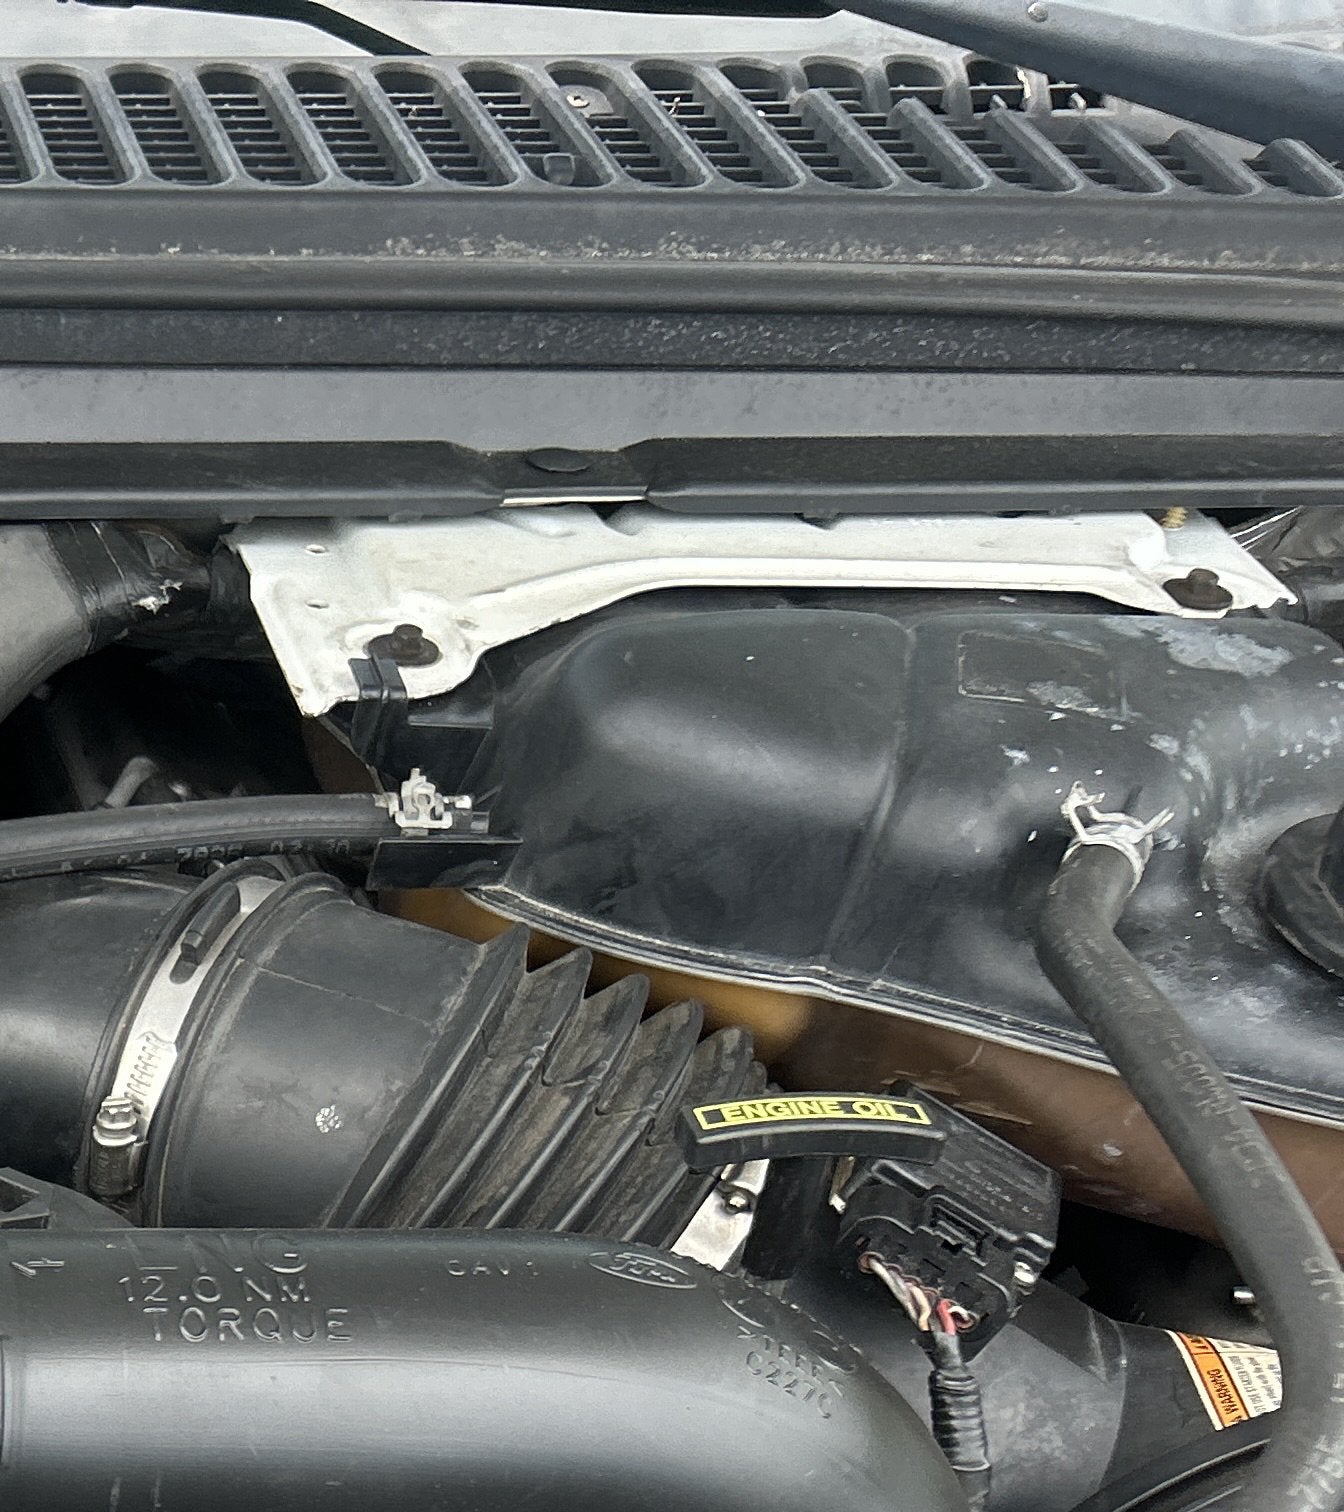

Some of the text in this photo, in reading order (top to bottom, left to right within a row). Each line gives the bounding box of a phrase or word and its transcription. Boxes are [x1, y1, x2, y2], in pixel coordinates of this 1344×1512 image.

[721, 1099, 908, 1123] ENGINE OIL
[118, 1275, 311, 1303] 12.0 NM
[142, 1306, 353, 1343] TORQUE
